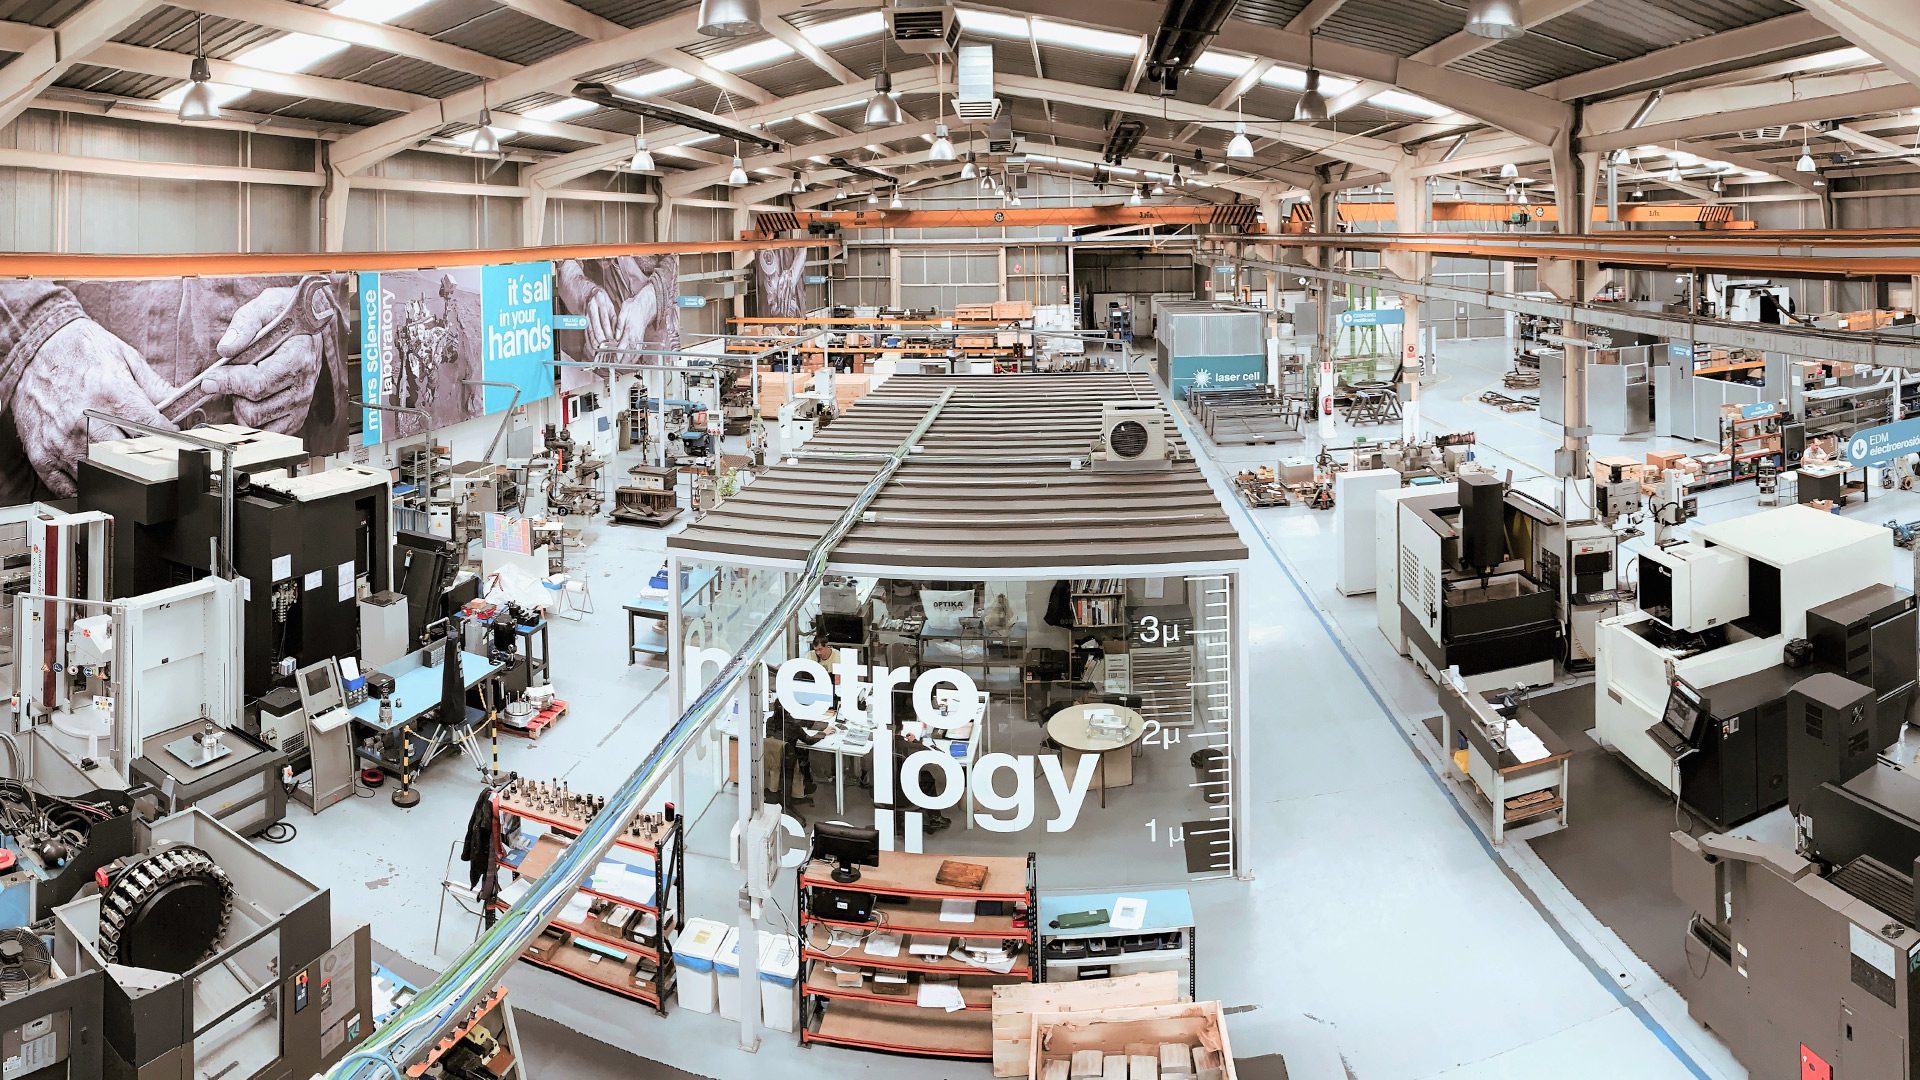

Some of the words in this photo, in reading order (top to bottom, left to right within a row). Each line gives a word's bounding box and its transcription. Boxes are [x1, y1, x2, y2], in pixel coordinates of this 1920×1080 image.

[364, 289, 379, 373] science
[381, 288, 396, 396] laboratory
[488, 318, 551, 361] hands
[500, 310, 510, 327] in
[511, 307, 537, 329] your
[1215, 373, 1240, 382] laser
[1242, 371, 1260, 381] cell
[367, 377, 379, 431] mars
[1869, 432, 1889, 445] EDM
[873, 728, 1101, 833] logy
[730, 808, 923, 867] cll
